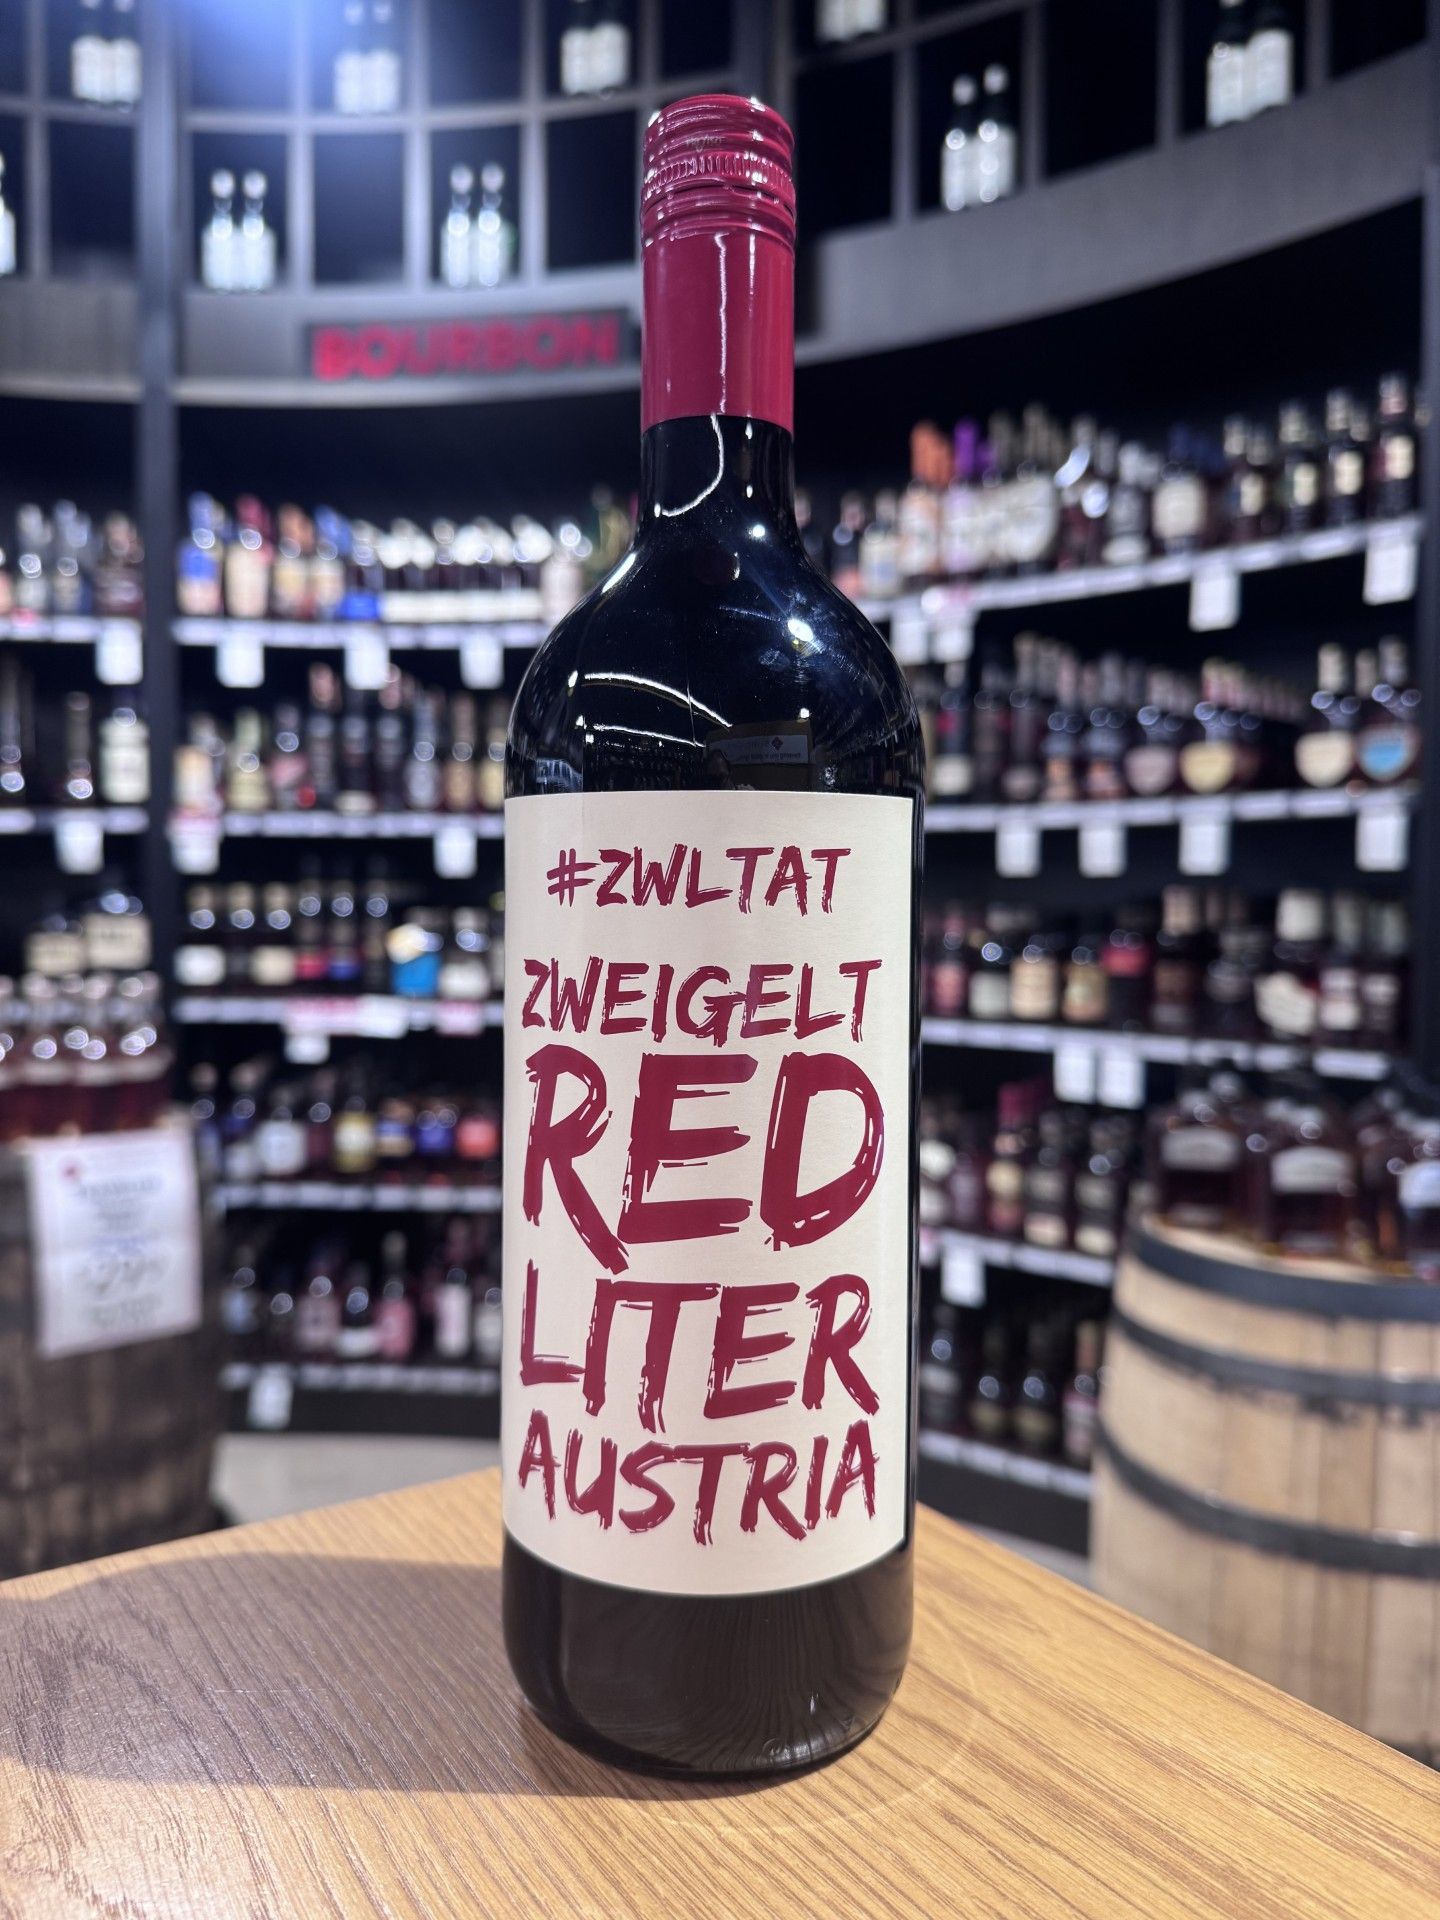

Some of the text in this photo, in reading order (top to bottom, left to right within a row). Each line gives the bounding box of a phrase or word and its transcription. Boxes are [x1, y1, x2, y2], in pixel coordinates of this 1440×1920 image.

[312, 314, 619, 380] BOURBON
[547, 844, 850, 914] #ZWLTAT
[522, 956, 882, 1046] ZWEIGELT
[523, 1044, 883, 1274] RED
[520, 1259, 879, 1435] LITER
[519, 1410, 878, 1546] AUSTRIA
